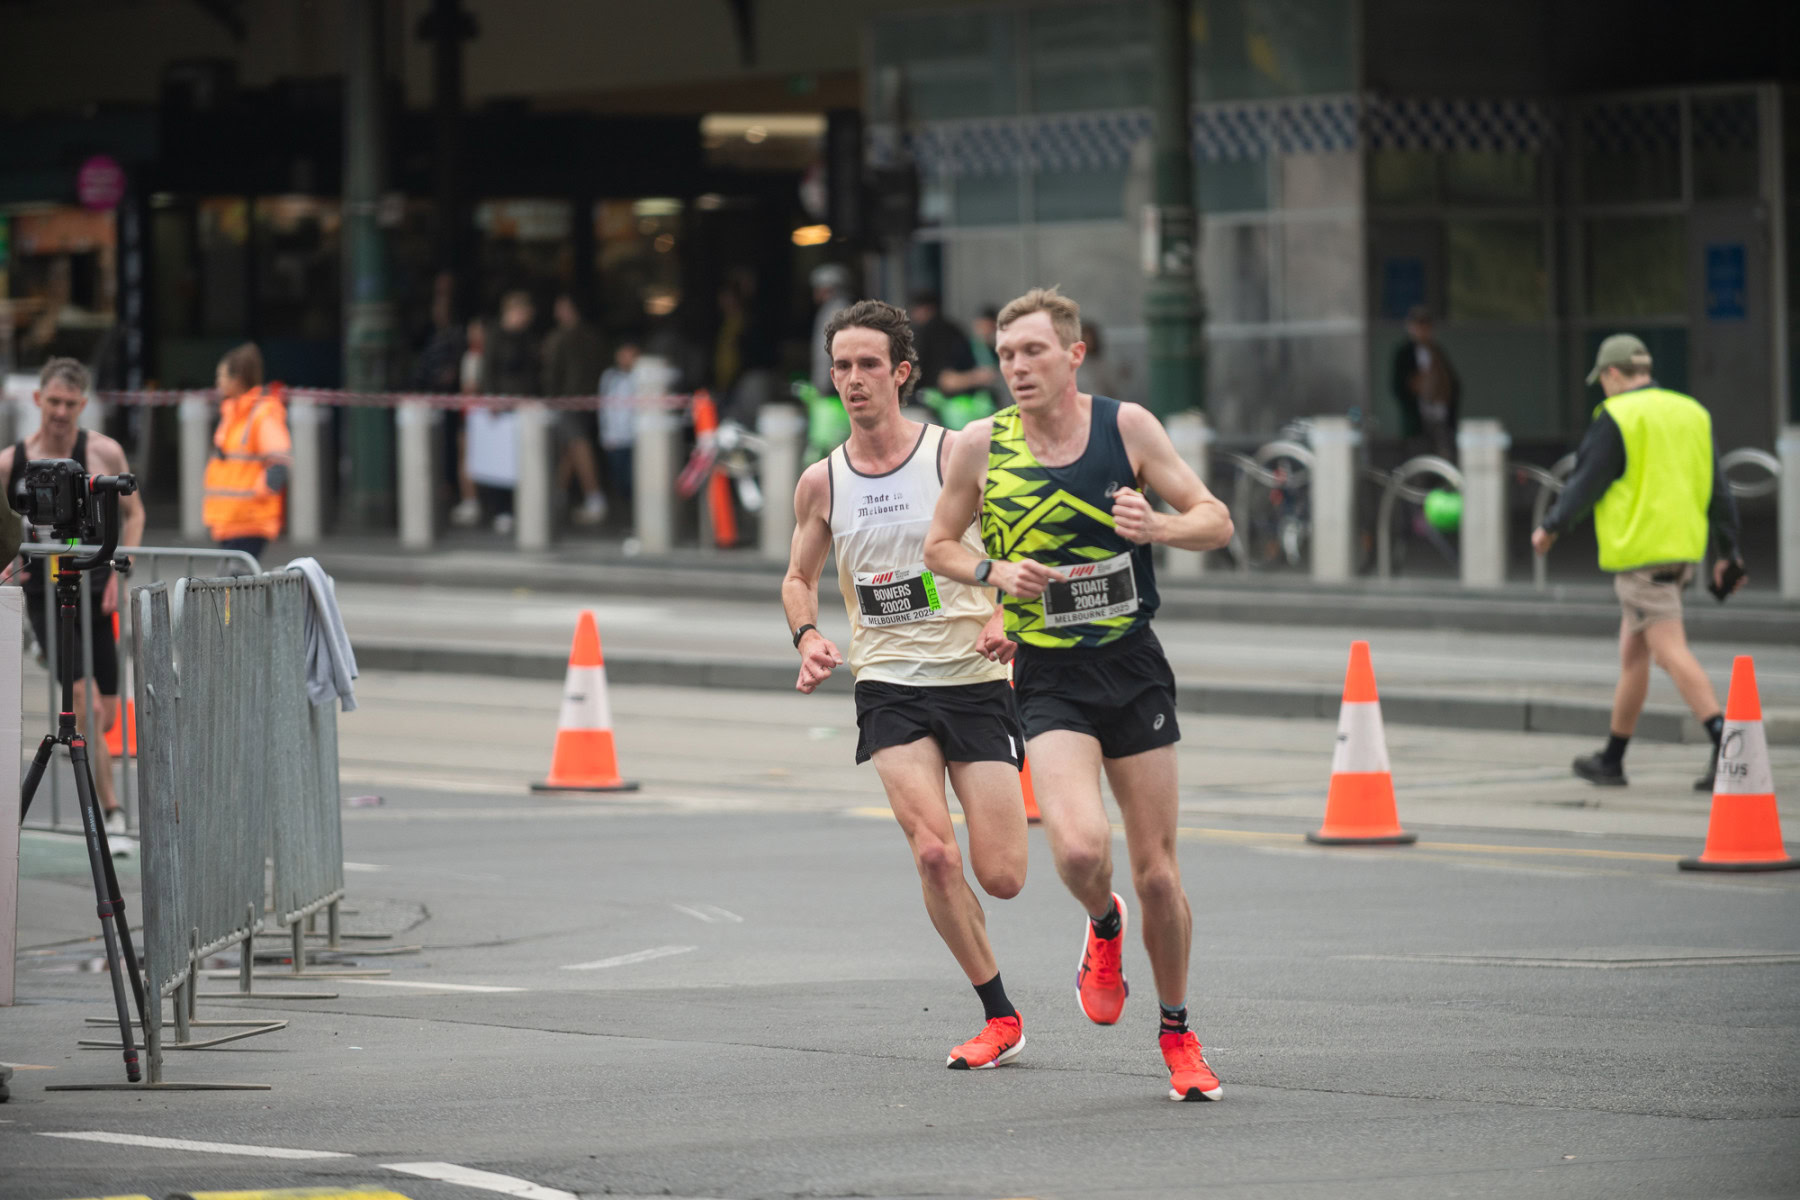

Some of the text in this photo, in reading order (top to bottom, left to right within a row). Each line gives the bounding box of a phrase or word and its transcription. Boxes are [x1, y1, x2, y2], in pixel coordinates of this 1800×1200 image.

[862, 493, 889, 505] Made
[858, 503, 910, 518] Melbourne
[872, 583, 912, 602] BOWERS
[1070, 578, 1110, 596] STOATE
[880, 597, 912, 614] 20020
[927, 587, 941, 611] ELITE
[1075, 592, 1109, 610] 20044
[868, 613, 912, 625] MELBOURNE
[1054, 603, 1130, 624] MELBOURNE 2025
